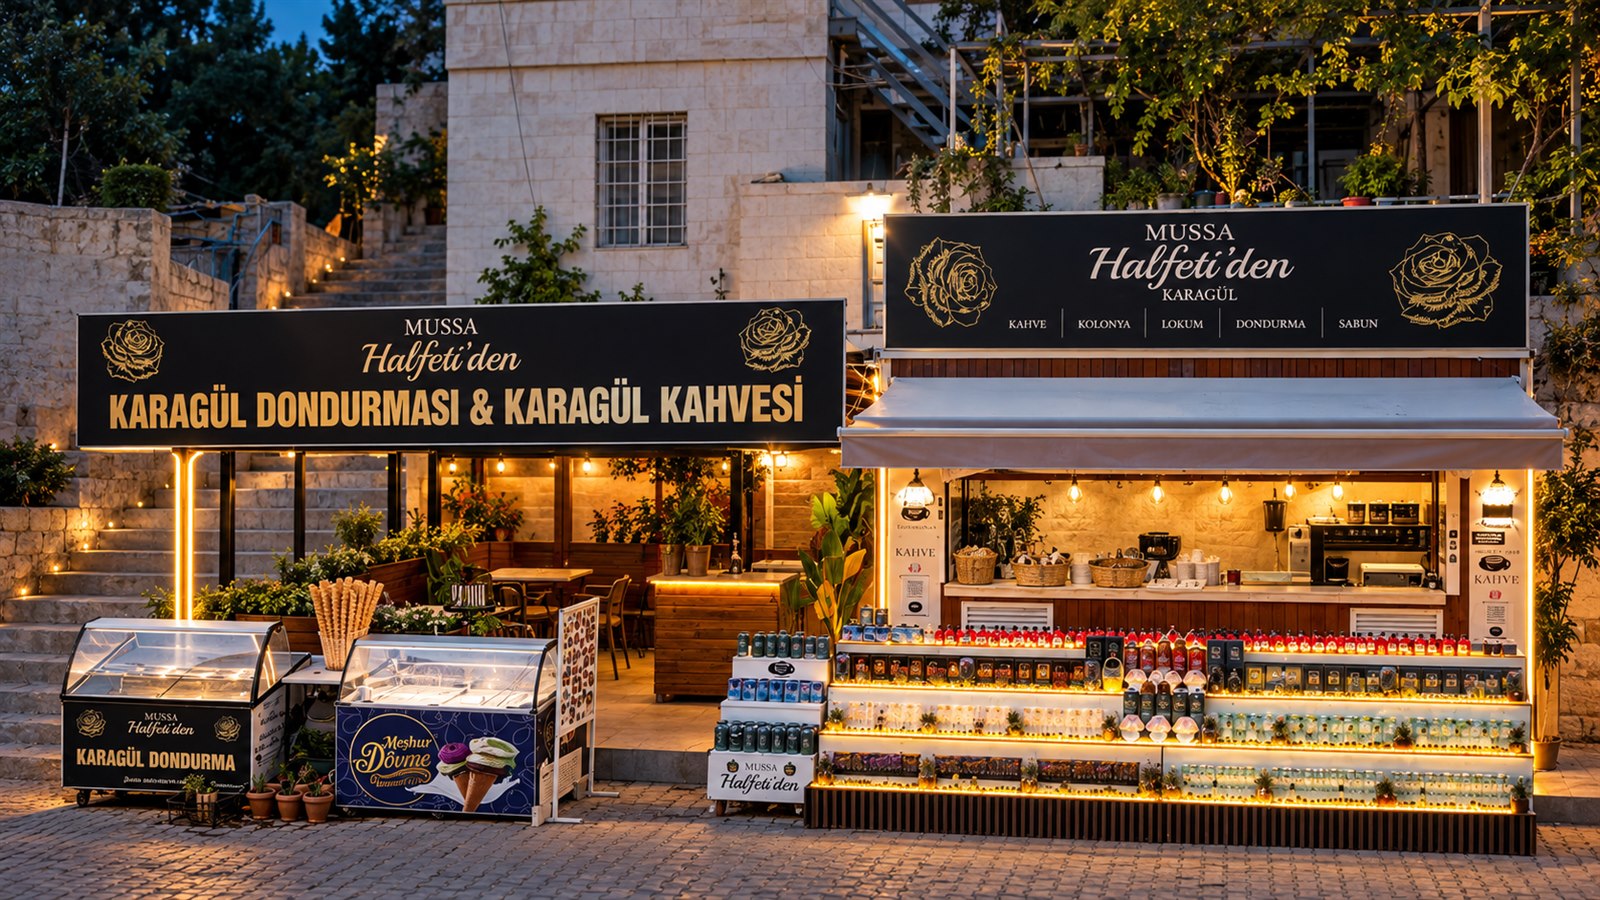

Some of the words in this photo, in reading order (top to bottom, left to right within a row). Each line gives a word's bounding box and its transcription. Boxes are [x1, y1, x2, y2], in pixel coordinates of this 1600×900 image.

[1145, 223, 1235, 242] MUSSA
[1089, 244, 1295, 290] Halfeti'den
[1162, 286, 1238, 302] KARAGÜL
[404, 317, 478, 336] MUSSA
[1008, 319, 1047, 329] KAHVE
[1078, 319, 1131, 329] KOLONYA
[1162, 319, 1204, 329] LOKUM
[1236, 319, 1306, 329] DONDURMA
[1338, 319, 1379, 329] SABUN
[361, 340, 522, 382] Halfeti'den
[109, 384, 247, 430] KARAGÜL
[256, 388, 459, 428] DONDURMASI
[469, 388, 494, 426] &
[504, 378, 650, 425] KARAGÜL
[660, 375, 803, 424] KAHVESİ
[895, 548, 936, 558] KAHVE
[1474, 575, 1520, 585] KAHVE
[144, 712, 178, 722] MUSSA
[382, 735, 432, 751] Meşhur
[76, 746, 144, 768] KARAGÜL
[149, 751, 236, 772] DONDURMA
[745, 762, 778, 772] MUSSA
